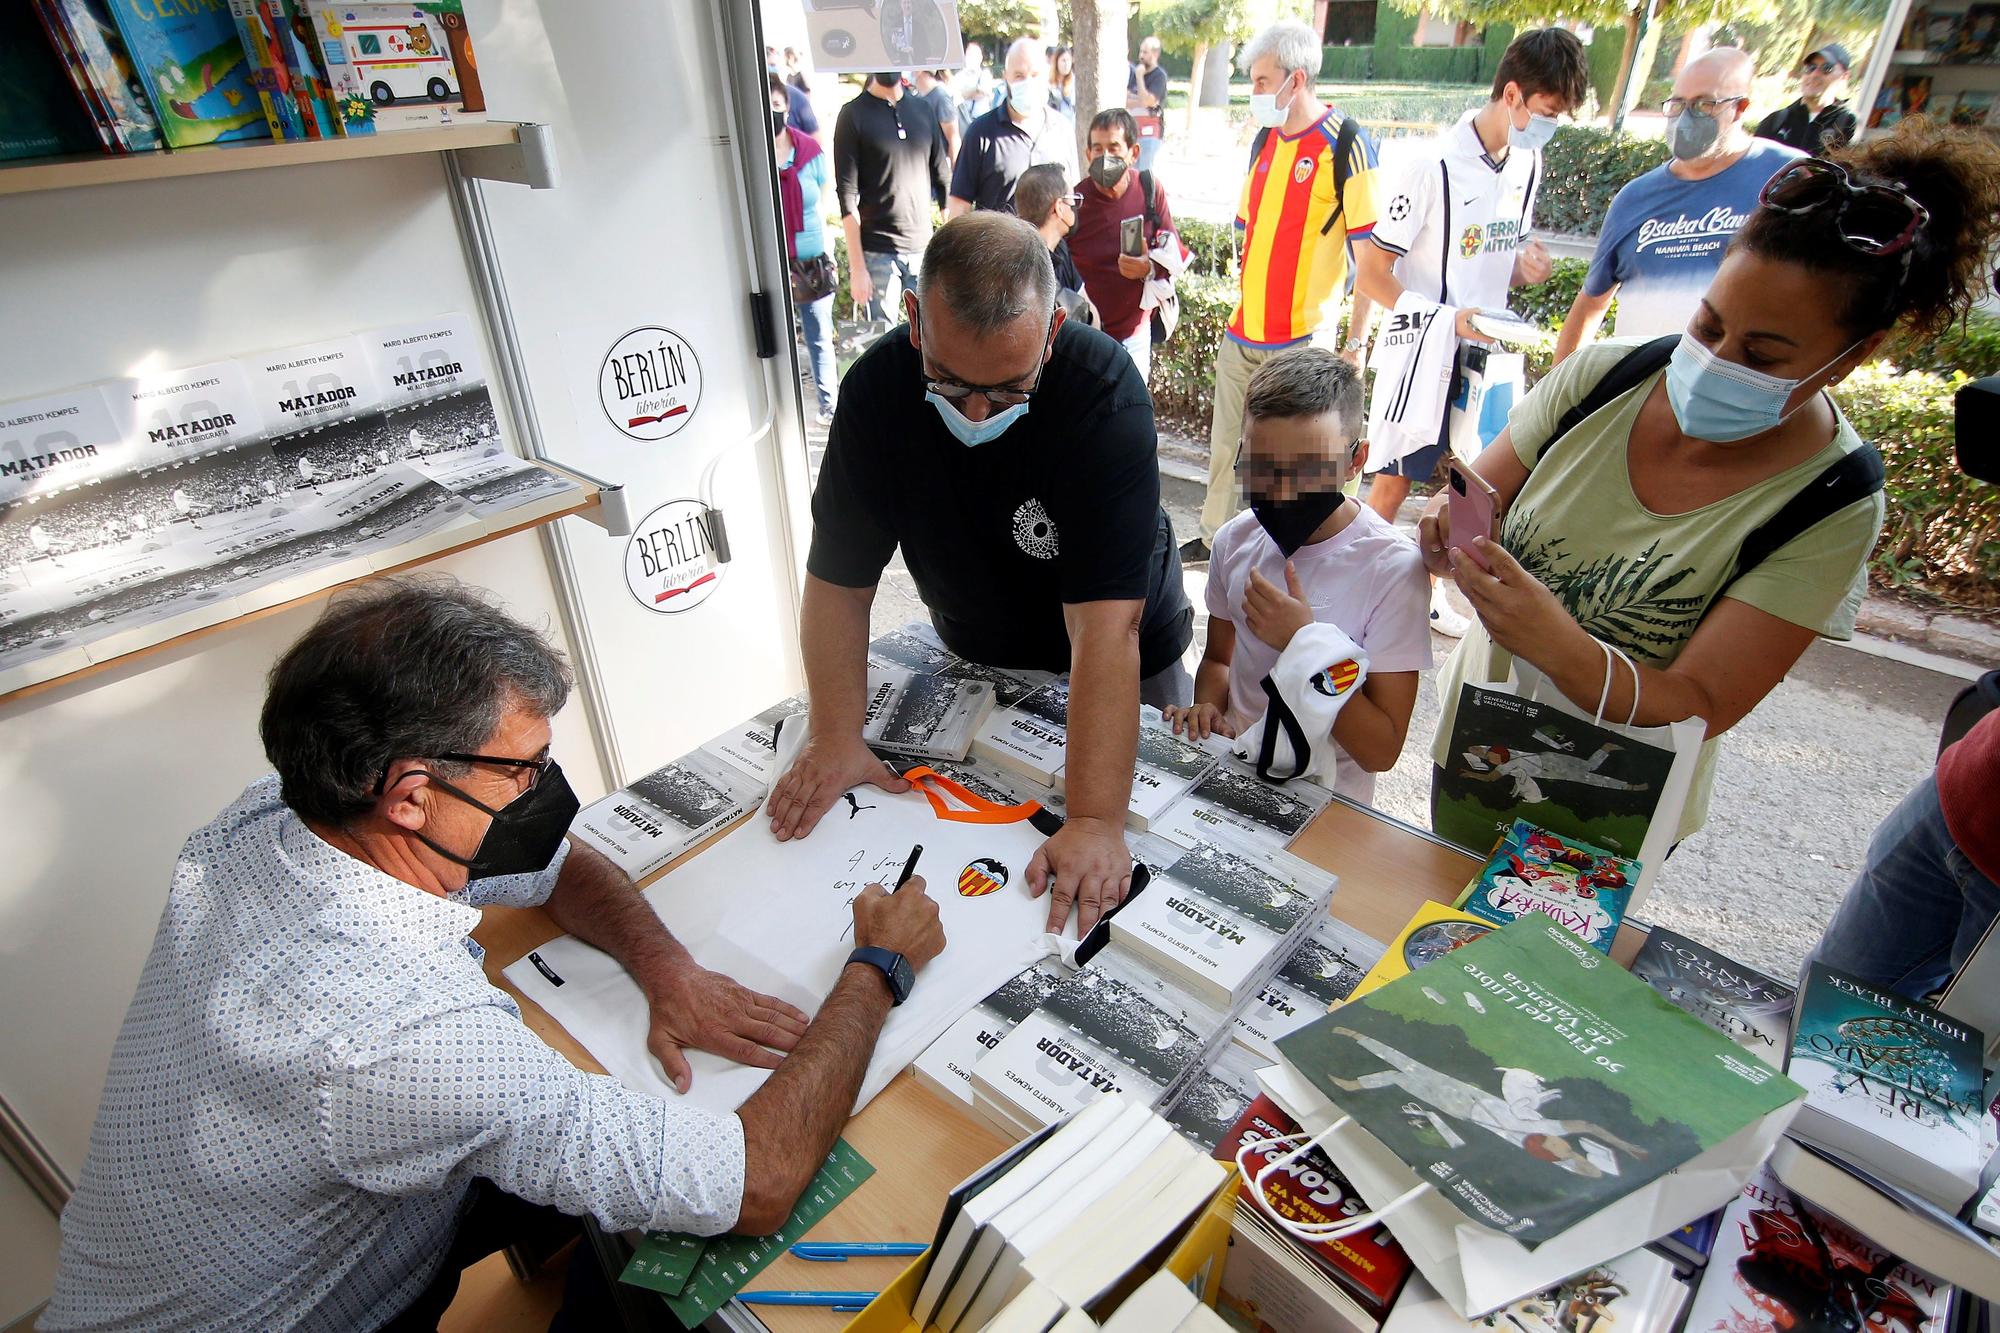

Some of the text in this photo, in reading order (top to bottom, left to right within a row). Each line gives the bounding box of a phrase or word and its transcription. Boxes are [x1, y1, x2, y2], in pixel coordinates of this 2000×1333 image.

[1637, 213, 1700, 243] Osaka
[1654, 241, 1720, 255] NANIWA BEACH
[383, 329, 453, 349] MARIO ALBERTO KEMPES
[266, 351, 344, 373] MARIO ALBERTO KEMPES
[392, 362, 464, 387] MATADOR
[609, 340, 688, 401] BERLÍN
[157, 383, 190, 398] ALBERTO
[189, 376, 221, 391] KEMPES
[278, 385, 357, 413] MATADOR
[406, 383, 416, 392] MI
[8, 413, 46, 427] ALBERTO
[45, 406, 80, 420] KEMPES
[294, 410, 303, 419] MI
[634, 391, 679, 417] librería
[148, 412, 237, 443] MATADOR
[166, 427, 230, 449] MI AUTOBIOGRAFÍA
[0, 443, 99, 477] MATADOR
[336, 480, 405, 518] MATADOR
[635, 511, 716, 579] BERLÍN
[73, 564, 167, 597] MATADOR
[662, 563, 705, 592] librería
[1483, 695, 1522, 708] GENERALITAT
[1483, 700, 1520, 713] VALENCIANA
[1010, 719, 1066, 748] MATADOR
[1028, 751, 1044, 762] MARIO
[612, 804, 664, 839] MATADOR
[714, 807, 744, 830] MATADOR
[1494, 821, 1512, 833] 56
[1164, 895, 1247, 946] MATADOR
[1183, 896, 1241, 931] MI AUTOBIOGRAFÍA
[1141, 921, 1218, 969] MARIO ALBERTO KEMPES
[1462, 963, 1519, 1003] Llibre
[1660, 940, 1778, 1003] SANTOS
[1677, 957, 1753, 1000] CARE
[1822, 974, 1893, 1009] BLACK
[1515, 1002, 1553, 1024] del
[1899, 1007, 1969, 1043] HOLLY
[1246, 1025, 1268, 1041] MARIO
[1553, 1023, 1599, 1056] Fira
[1584, 1027, 1615, 1046] de
[1035, 1035, 1123, 1096] MATADOR
[1056, 1036, 1118, 1080] MI AUTOBIOGRAFÍA
[1592, 1055, 1625, 1074] 56
[1810, 1033, 1972, 1118] MALVADO
[1003, 1068, 1065, 1115] ALBERTO KEMPES
[1844, 1073, 1936, 1130] REY
[1875, 1104, 1893, 1119] EL
[1238, 1129, 1342, 1205] COMPAS
[1451, 1183, 1508, 1226] GENERALITAT
[1461, 1179, 1515, 1223] VALENCIANA
